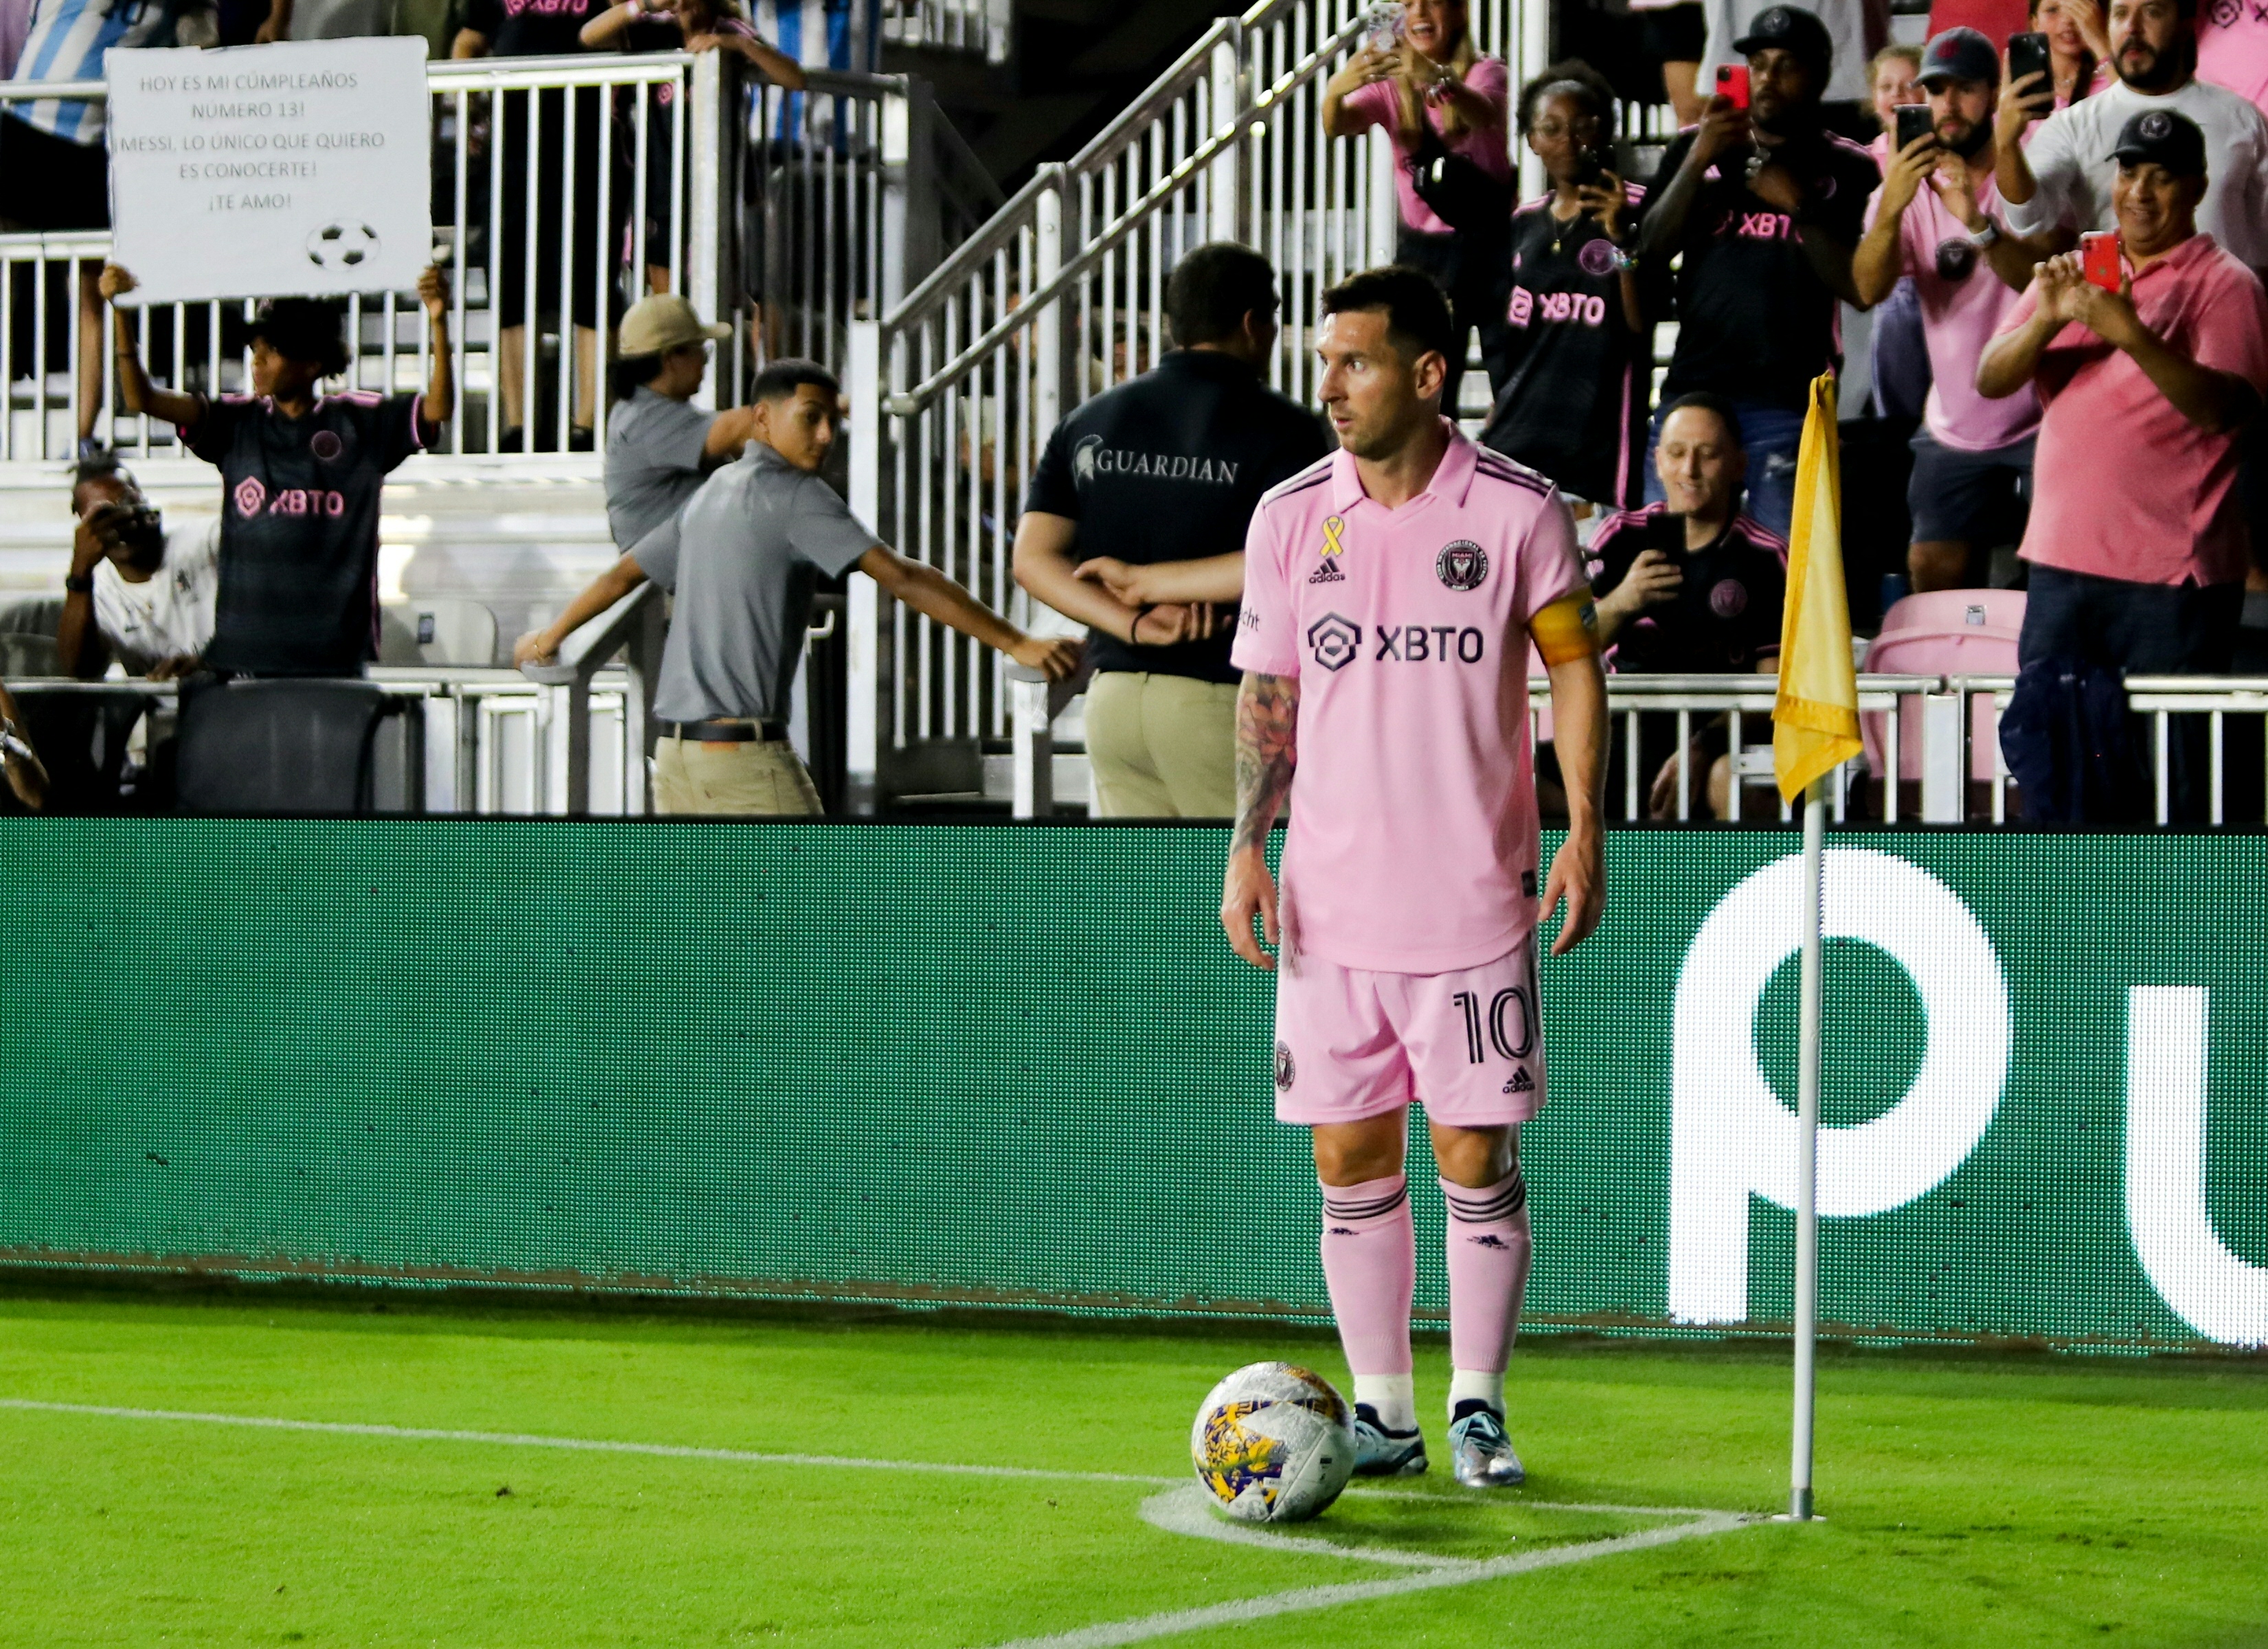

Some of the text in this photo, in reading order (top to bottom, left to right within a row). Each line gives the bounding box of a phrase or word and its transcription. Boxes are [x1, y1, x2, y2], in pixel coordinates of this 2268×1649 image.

[141, 76, 177, 92] HOY
[183, 75, 201, 91] ES
[208, 75, 229, 90] MI
[279, 102, 304, 118] 13!
[184, 135, 205, 150] LO
[211, 131, 267, 150] ÚNICO
[273, 134, 310, 150] QUE
[316, 133, 385, 149] QUIERO
[180, 161, 317, 178] ES CONOCERTE!
[210, 193, 291, 211] ¡TE AMO!
[1738, 212, 1803, 243] XBT
[1538, 292, 1605, 326] XBTO
[1098, 449, 1238, 484] GUARDIAN
[269, 488, 344, 515] XBTO
[1309, 573, 1346, 584] adidas
[1240, 607, 1260, 631] cht
[1376, 625, 1484, 663] XBTO
[1453, 984, 1534, 1064] 10
